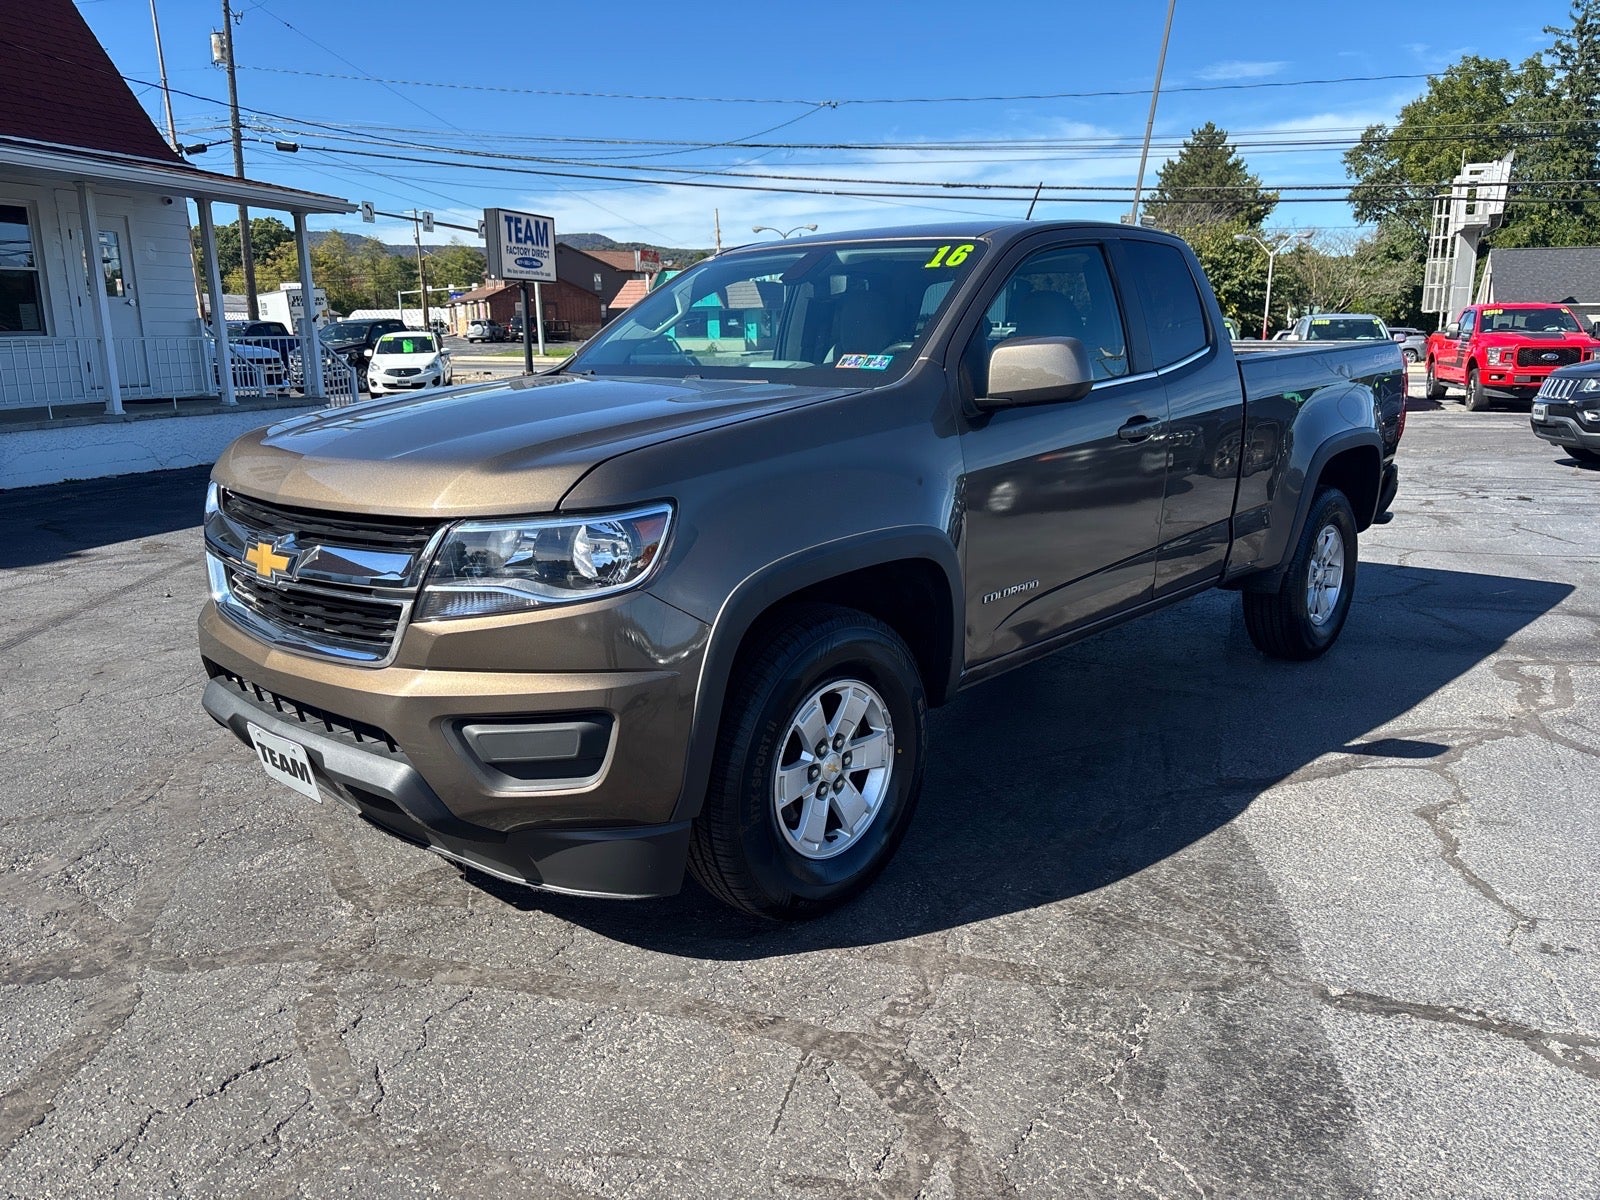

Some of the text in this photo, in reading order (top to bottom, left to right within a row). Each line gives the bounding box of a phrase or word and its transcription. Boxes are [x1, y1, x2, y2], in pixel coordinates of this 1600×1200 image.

[504, 215, 549, 248] TEAM
[506, 245, 550, 259] FACTORY DIRECT
[924, 244, 975, 268] 16
[983, 580, 1039, 604] COLORADO
[256, 741, 312, 785] TEAM
[752, 734, 771, 788] SPORT
